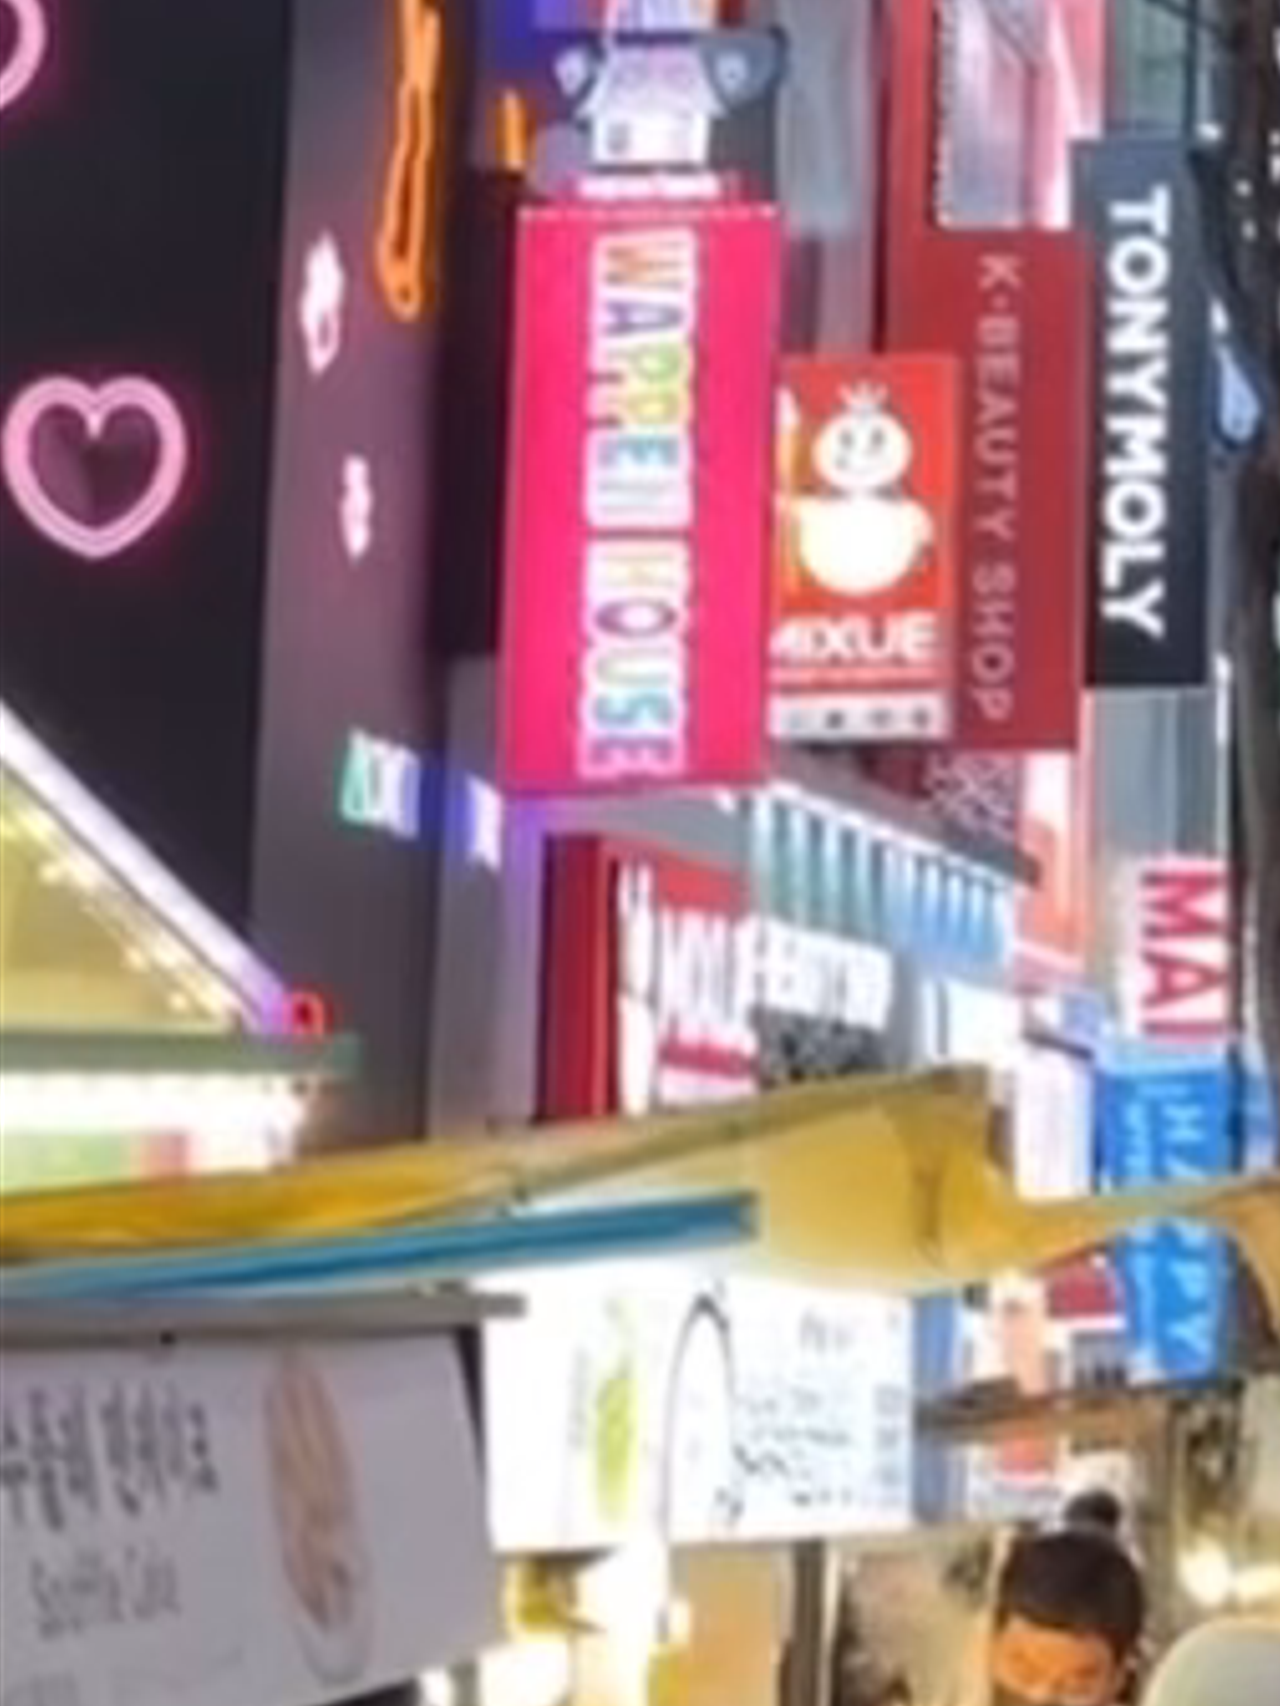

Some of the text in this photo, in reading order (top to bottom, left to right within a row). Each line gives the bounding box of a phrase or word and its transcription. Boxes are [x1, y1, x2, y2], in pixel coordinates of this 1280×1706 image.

[578, 228, 696, 776] WAPPEN HOUSE
[1098, 184, 1171, 638] TONYMOLY
[971, 559, 1018, 721] SHOP
